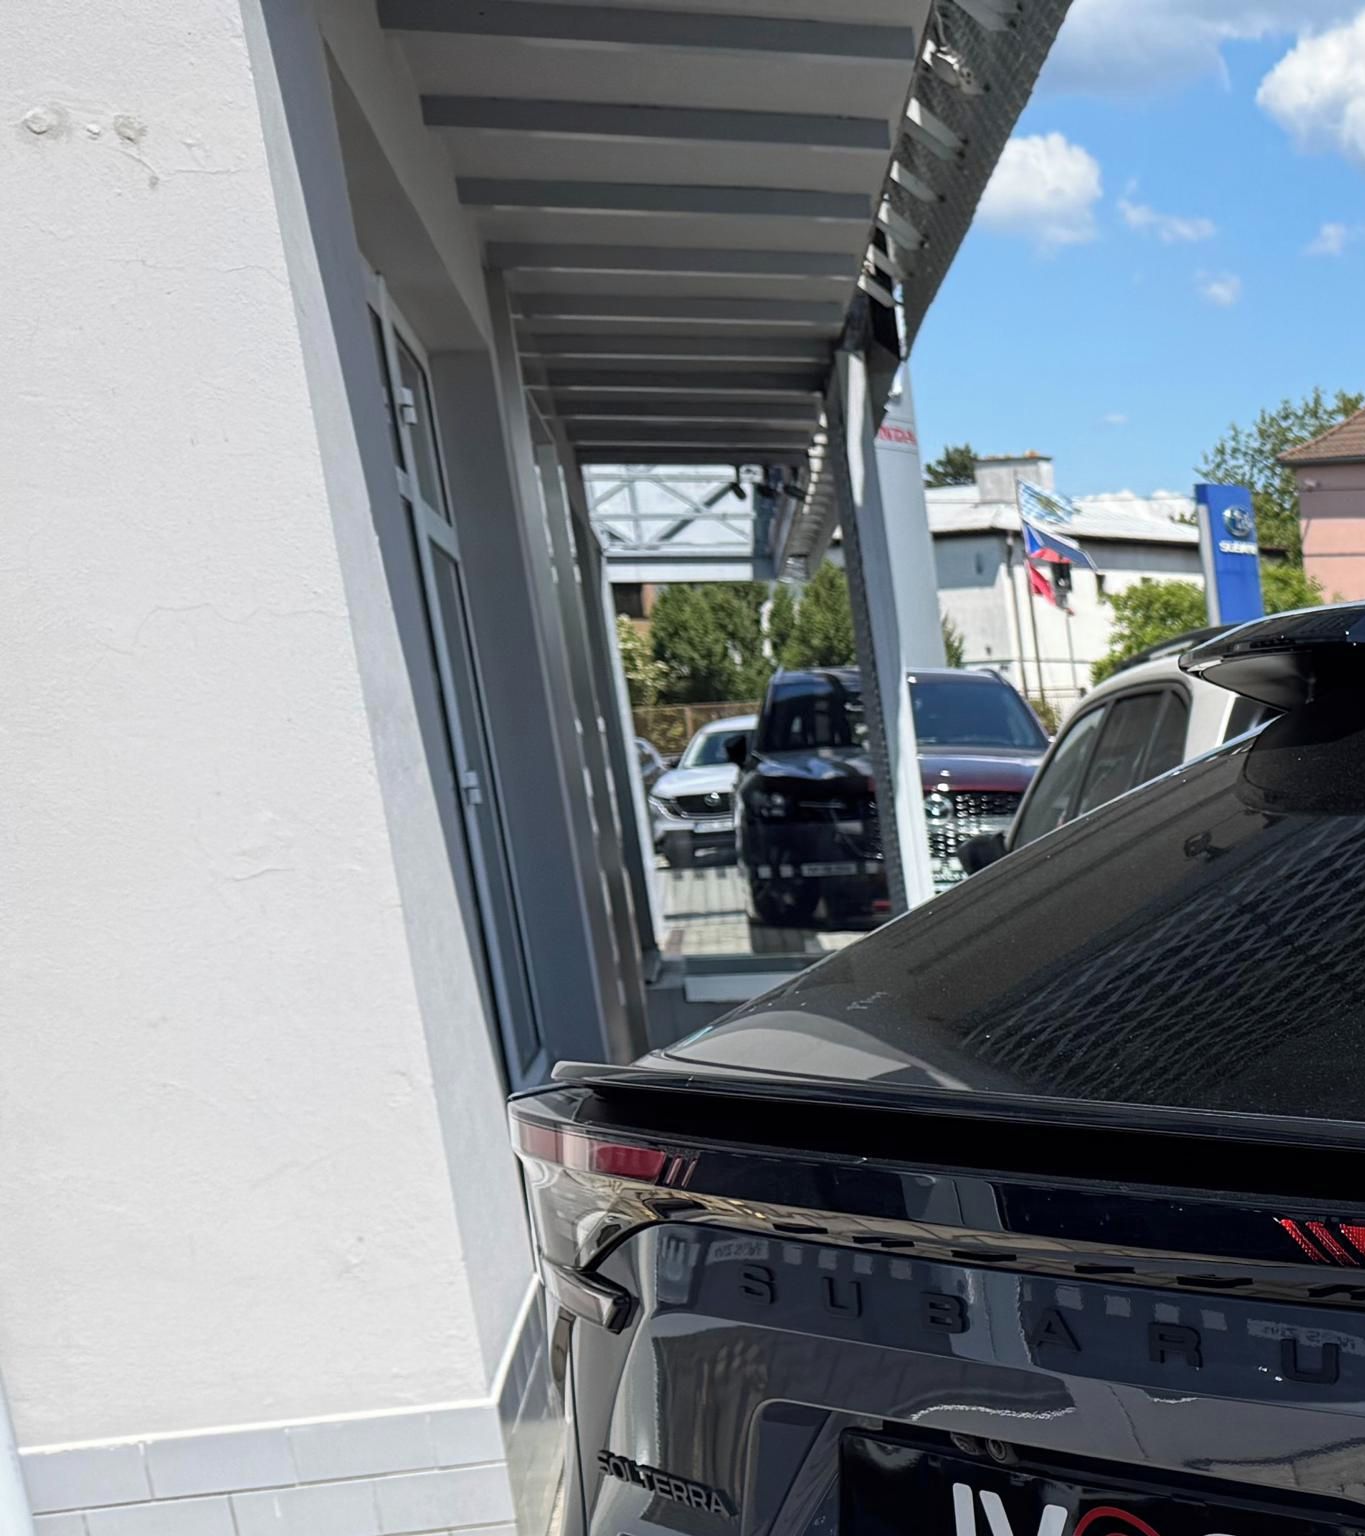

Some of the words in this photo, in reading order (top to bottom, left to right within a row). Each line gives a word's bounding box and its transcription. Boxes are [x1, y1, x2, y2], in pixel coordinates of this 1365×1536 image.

[880, 426, 917, 446] NDA
[737, 1264, 1341, 1385] SUBARU
[598, 1450, 737, 1518] SOLTERRA
